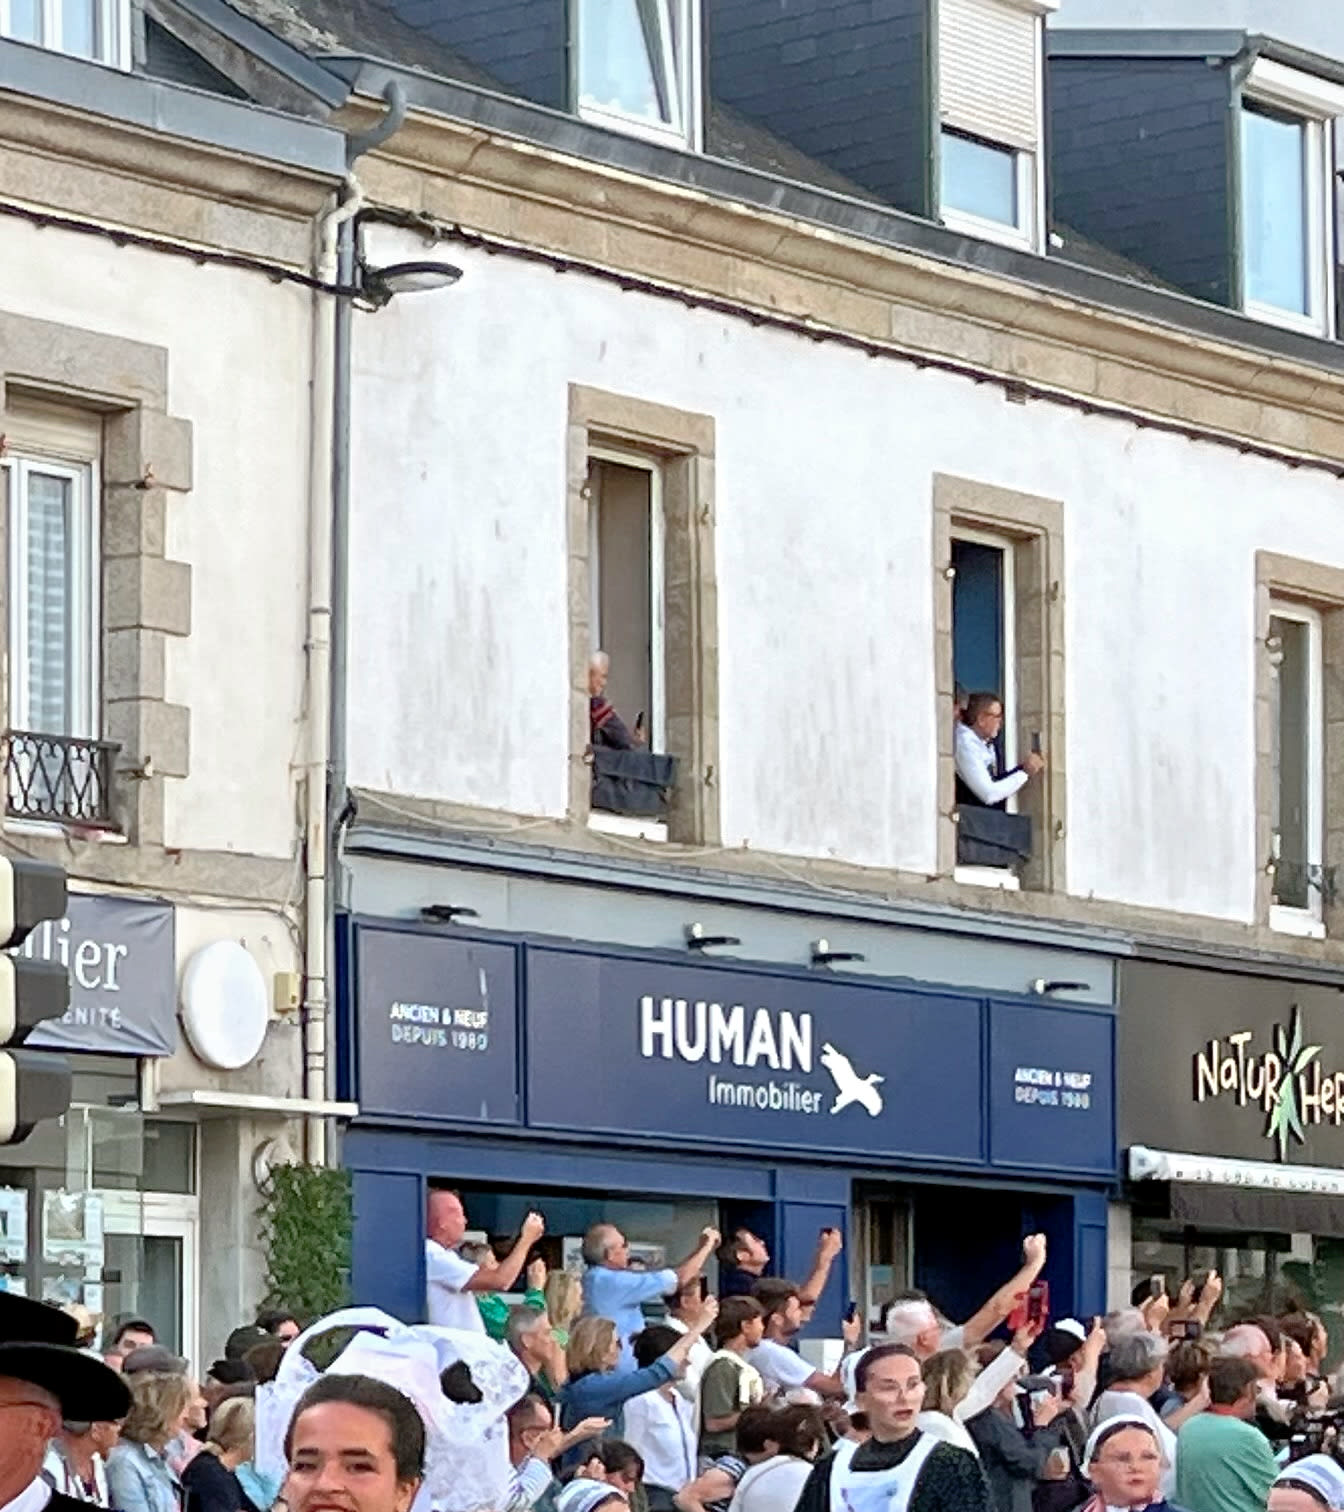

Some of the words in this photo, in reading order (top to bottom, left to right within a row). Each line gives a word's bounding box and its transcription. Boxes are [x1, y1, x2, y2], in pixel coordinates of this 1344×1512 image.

[392, 1023, 448, 1047] DEPUIS
[640, 995, 813, 1074] HUMAN
[709, 1075, 823, 1114] Immobilier
